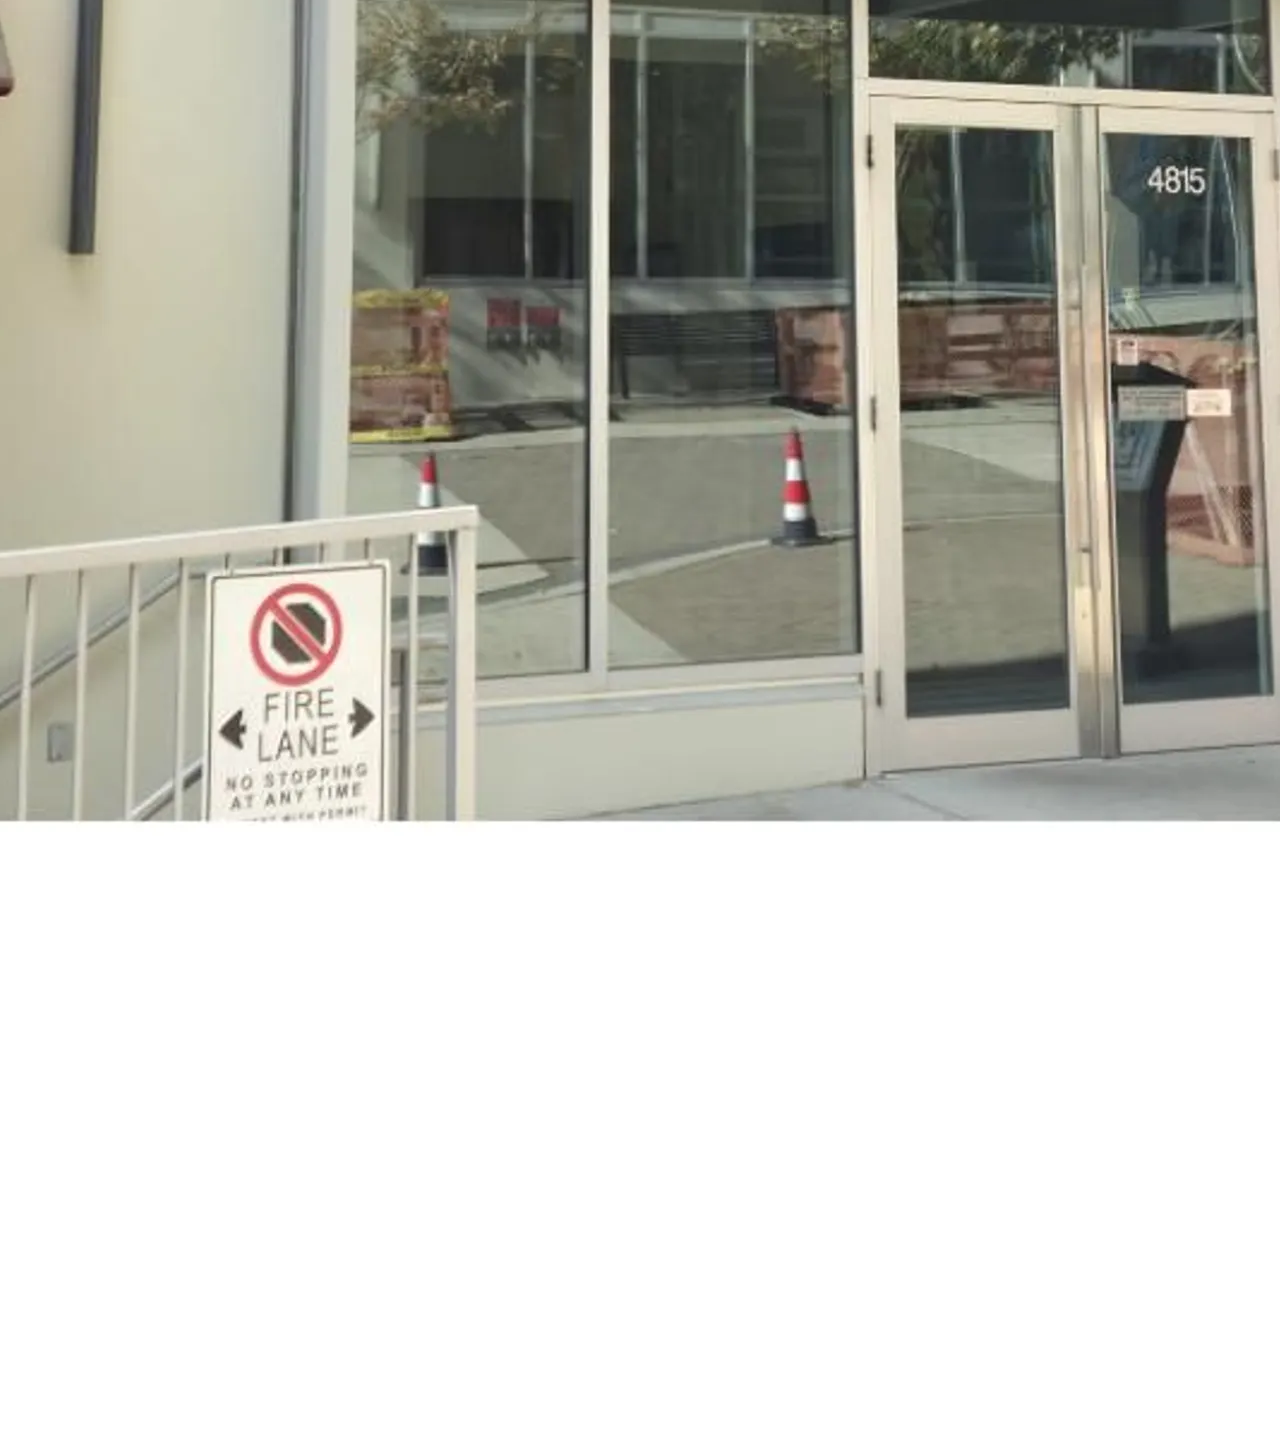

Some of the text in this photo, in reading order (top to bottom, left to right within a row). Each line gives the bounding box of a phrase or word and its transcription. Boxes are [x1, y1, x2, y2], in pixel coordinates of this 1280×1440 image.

[1147, 165, 1206, 194] 4815
[264, 687, 334, 724] FIRE
[258, 724, 339, 763] LANE
[225, 763, 368, 791] NO STOPPING
[230, 782, 362, 810] AT ANY TIME
